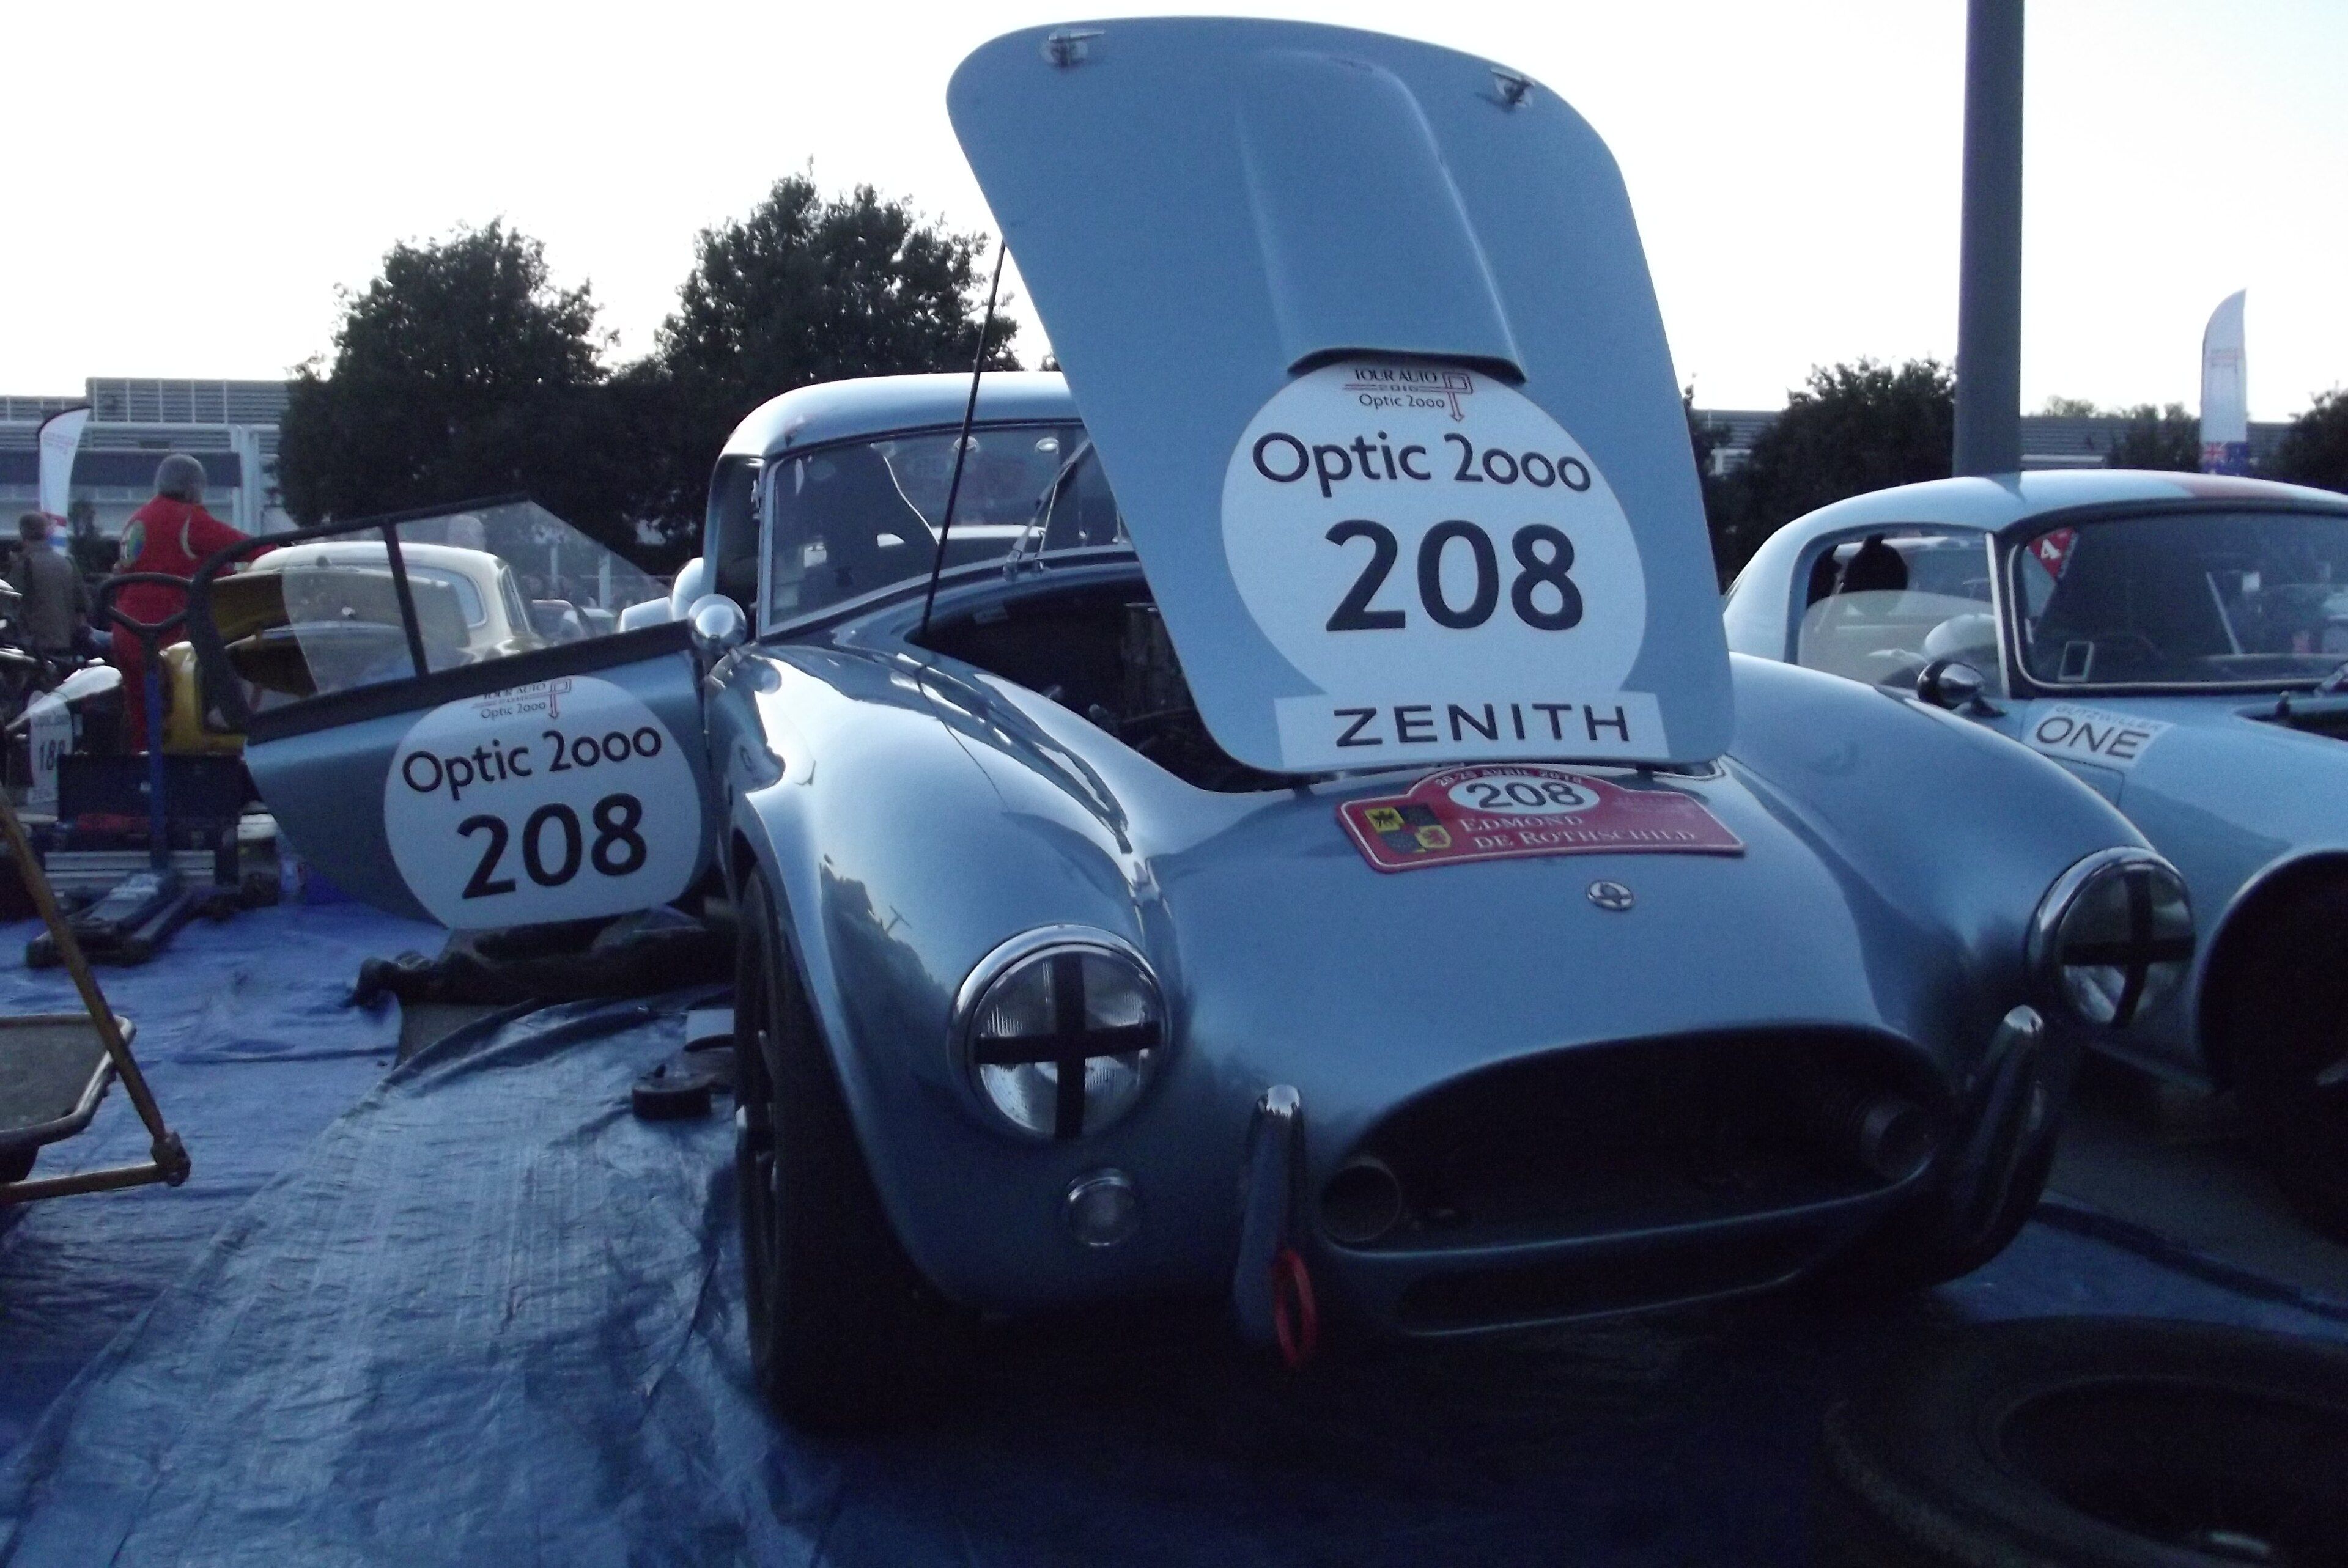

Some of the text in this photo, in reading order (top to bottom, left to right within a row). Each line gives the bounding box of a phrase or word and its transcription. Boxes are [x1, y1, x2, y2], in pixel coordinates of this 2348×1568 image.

[1354, 369, 1437, 383] TOUR AUTO
[1359, 393, 1445, 410] Optic 2000
[1252, 430, 1591, 498] Optic 2000
[2041, 539, 2061, 559] 4
[1325, 519, 1584, 631] 208
[481, 702, 546, 720] Optic 2000
[1334, 703, 1630, 747] ZENITH
[2036, 716, 2150, 759] ONE
[402, 726, 662, 801] Optic 2000
[1466, 782, 1585, 808] 208
[1460, 815, 1583, 831] EDMOND
[456, 792, 647, 899] 208
[1474, 830, 1696, 848] DE ROTHSCHILD
